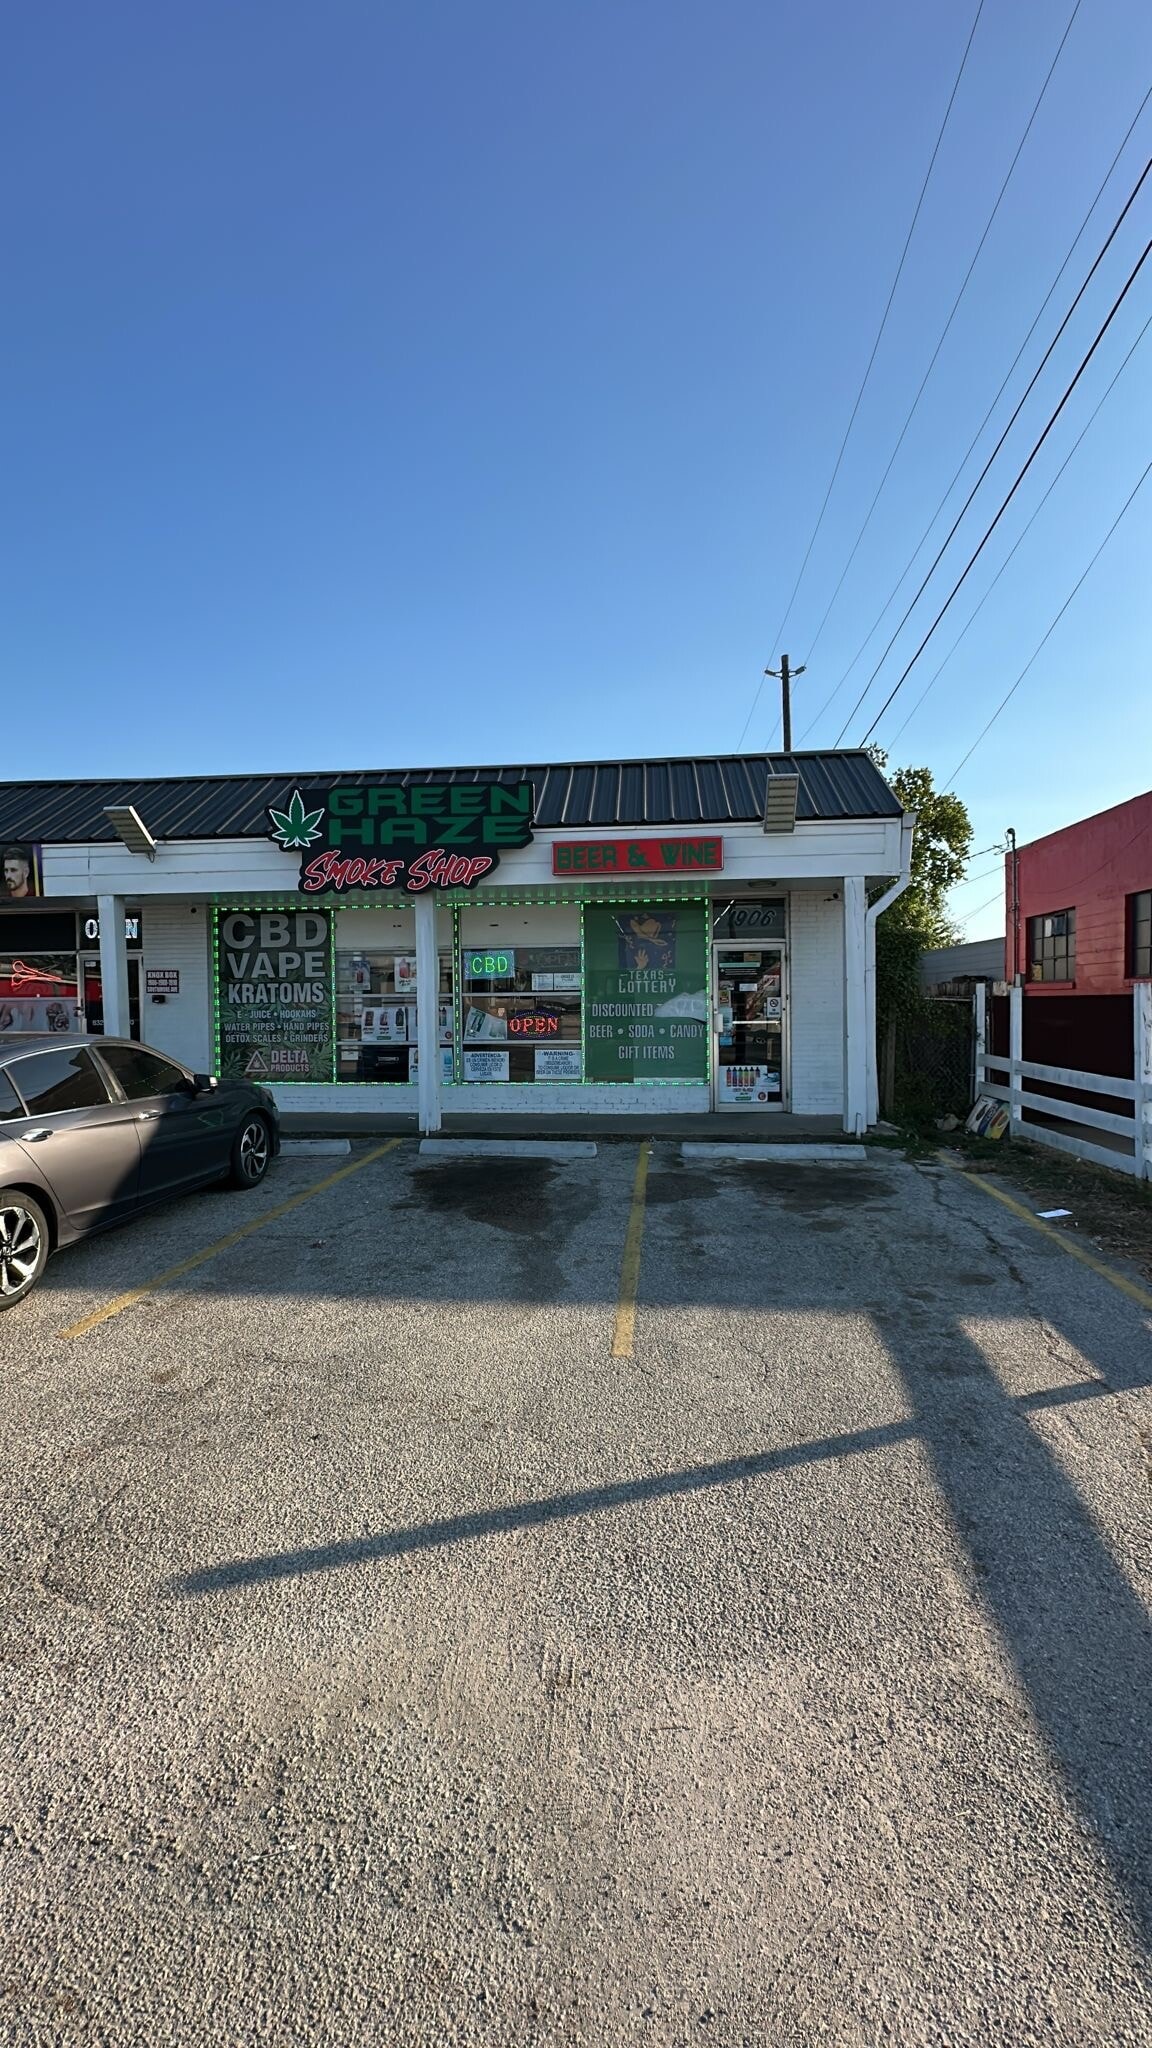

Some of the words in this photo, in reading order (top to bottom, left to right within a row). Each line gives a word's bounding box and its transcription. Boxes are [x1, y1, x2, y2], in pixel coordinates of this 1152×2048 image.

[329, 786, 530, 815] GREEN
[329, 816, 529, 845] HAZE
[557, 846, 616, 869] BEER
[628, 844, 648, 867] &
[661, 842, 716, 866] WINE
[85, 919, 139, 939] ON
[222, 913, 328, 949] CBD
[226, 951, 326, 979] VAPE
[472, 956, 508, 974] CBD
[629, 970, 665, 980] TEXAS
[228, 982, 325, 1004] KRATOMS
[618, 979, 676, 993] LOTTERY
[250, 1010, 272, 1019] JUICE
[592, 1003, 654, 1017] DISCOUNTED
[224, 1023, 251, 1032] WATER
[252, 1022, 276, 1032] PIPES
[283, 1022, 305, 1032] HAND
[307, 1022, 330, 1032] PIPES
[509, 1018, 558, 1032] OPEN
[589, 1024, 614, 1038] BEER
[628, 1024, 655, 1038] SODA
[670, 1024, 704, 1038] CANDY
[225, 1034, 251, 1043] DETOX
[253, 1034, 282, 1043] SCALES
[289, 1034, 329, 1043] GRINDERS
[271, 1050, 309, 1063] DELTA
[618, 1046, 641, 1060] GIFT
[643, 1045, 675, 1060] ITEMS
[270, 1064, 310, 1072] PRODUCTS
